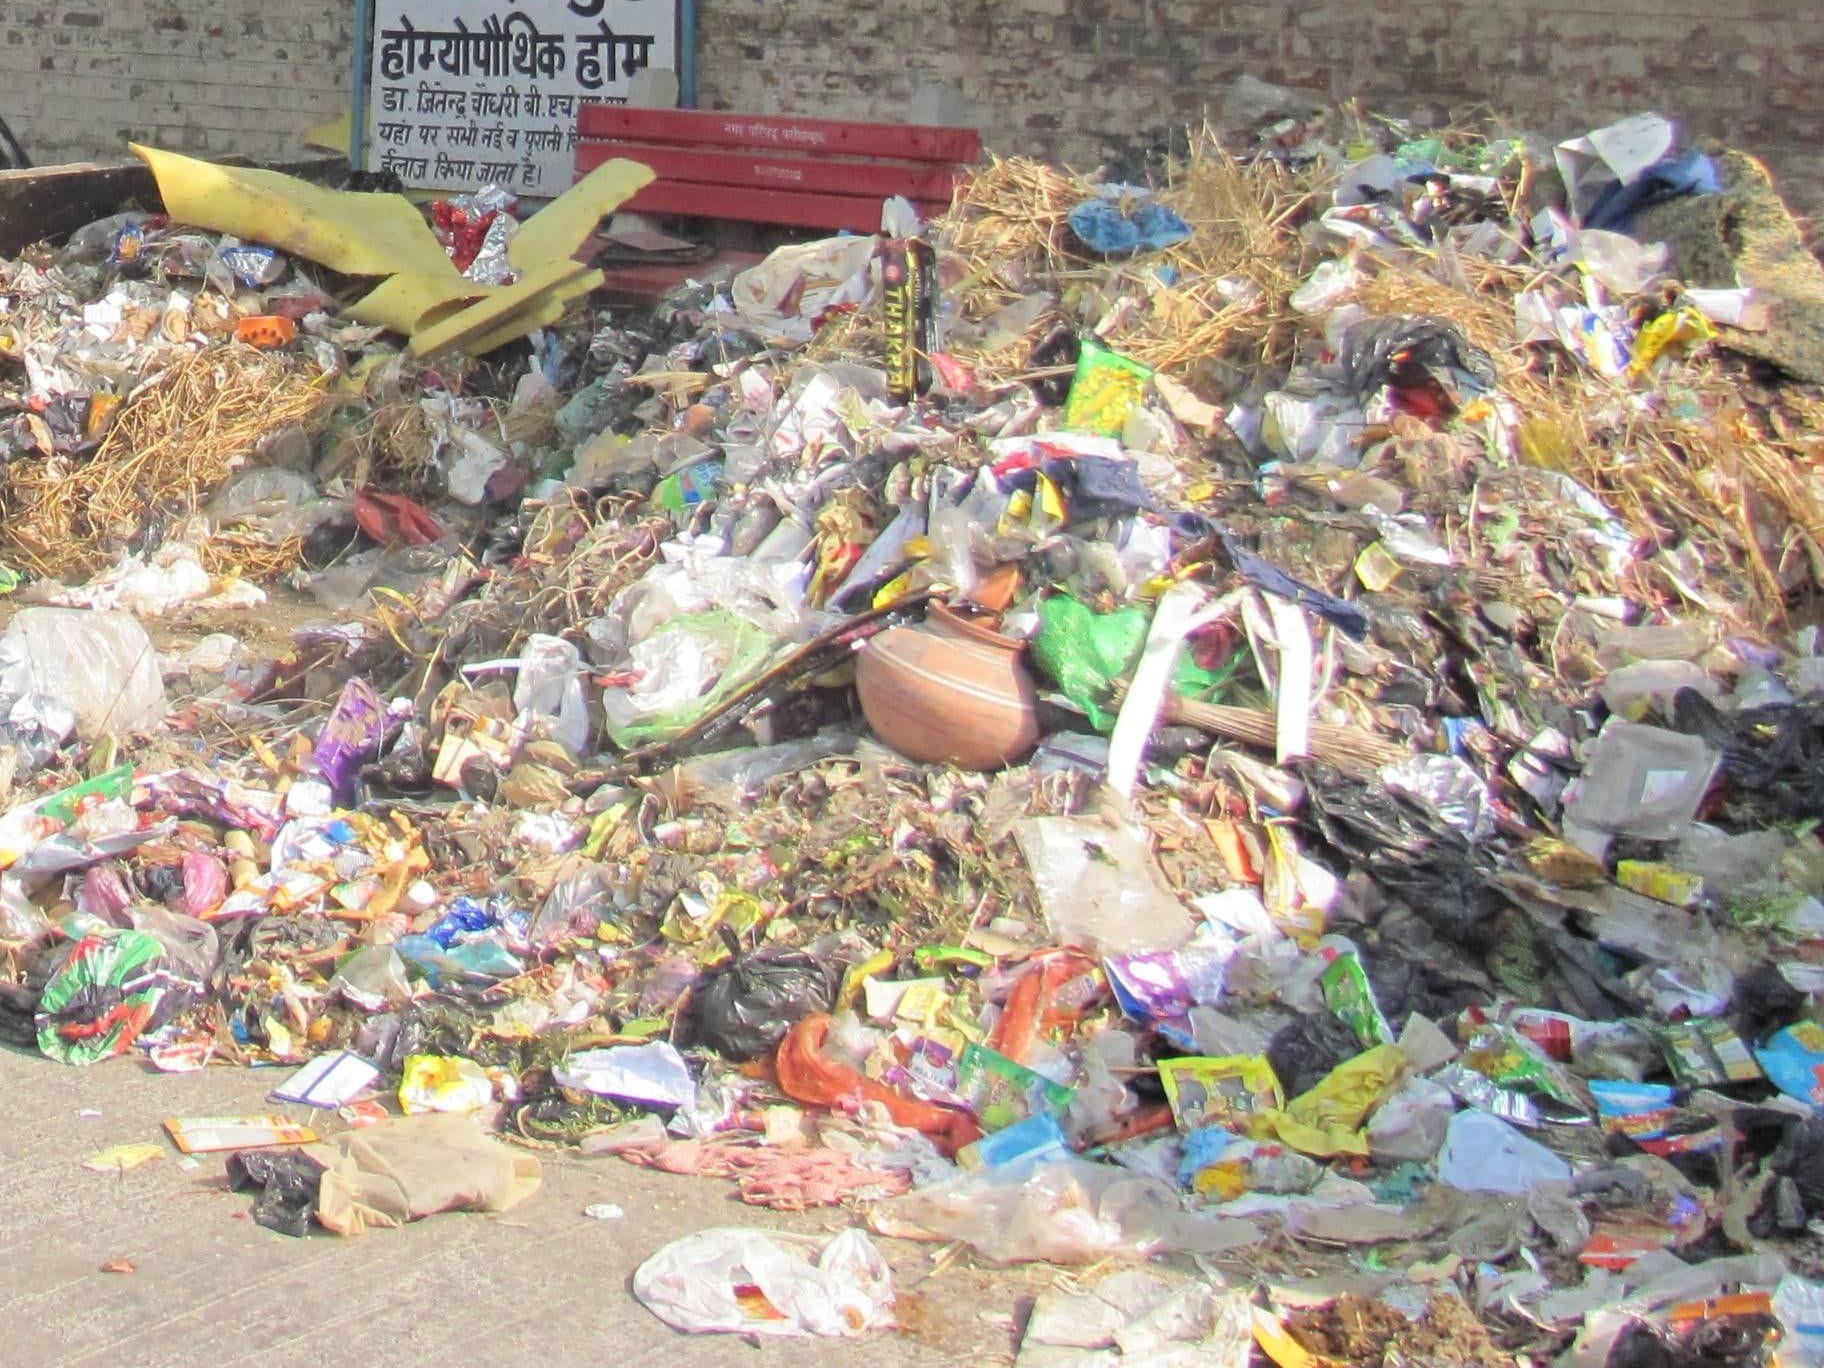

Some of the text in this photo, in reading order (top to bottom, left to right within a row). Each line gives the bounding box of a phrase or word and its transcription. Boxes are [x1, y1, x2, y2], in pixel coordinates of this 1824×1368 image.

[576, 18, 655, 89] होम
[418, 125, 442, 146] पर
[435, 152, 475, 180] किया
[477, 161, 518, 184] जाता
